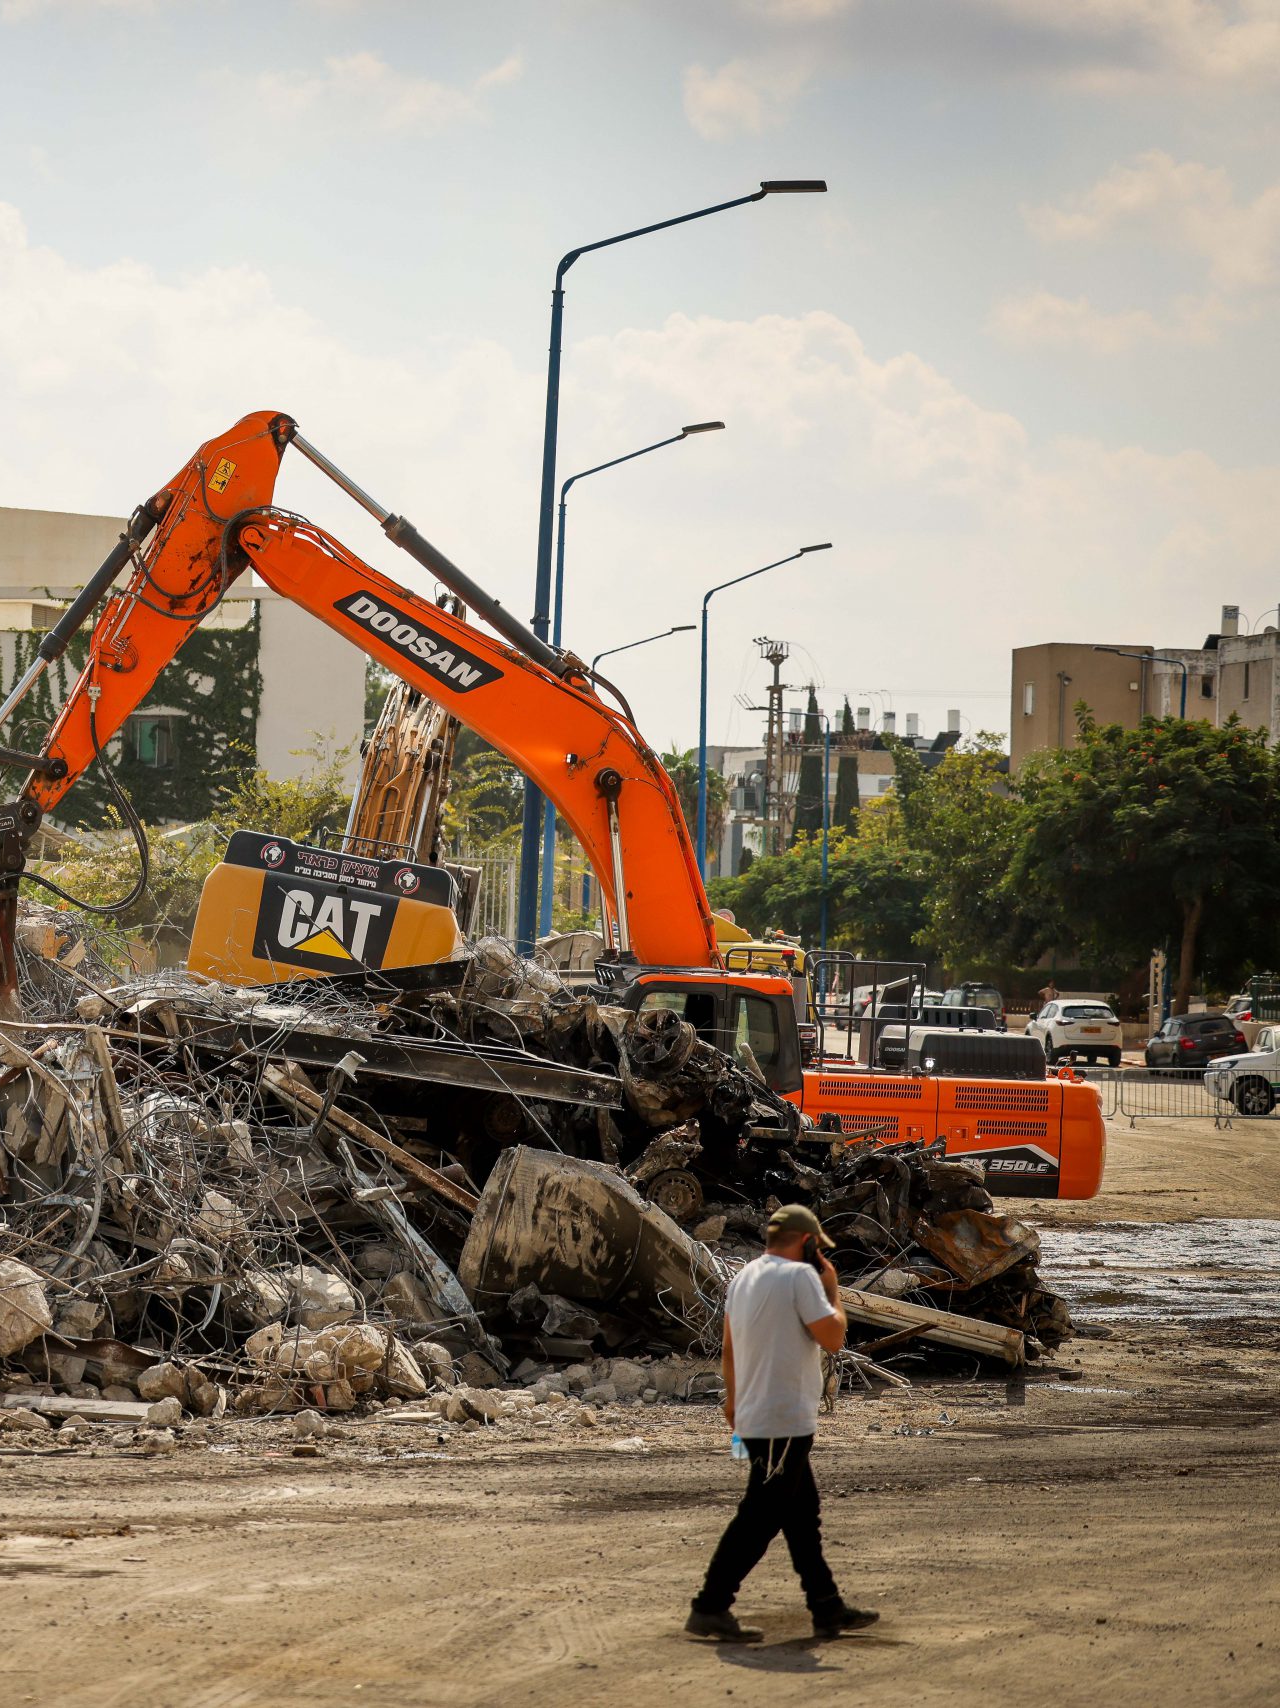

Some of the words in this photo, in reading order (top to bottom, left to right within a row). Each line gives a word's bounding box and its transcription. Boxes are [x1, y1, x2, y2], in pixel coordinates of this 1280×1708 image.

[347, 596, 483, 687] DOOSAN
[340, 860, 380, 878] איציק
[277, 889, 382, 962] CAT
